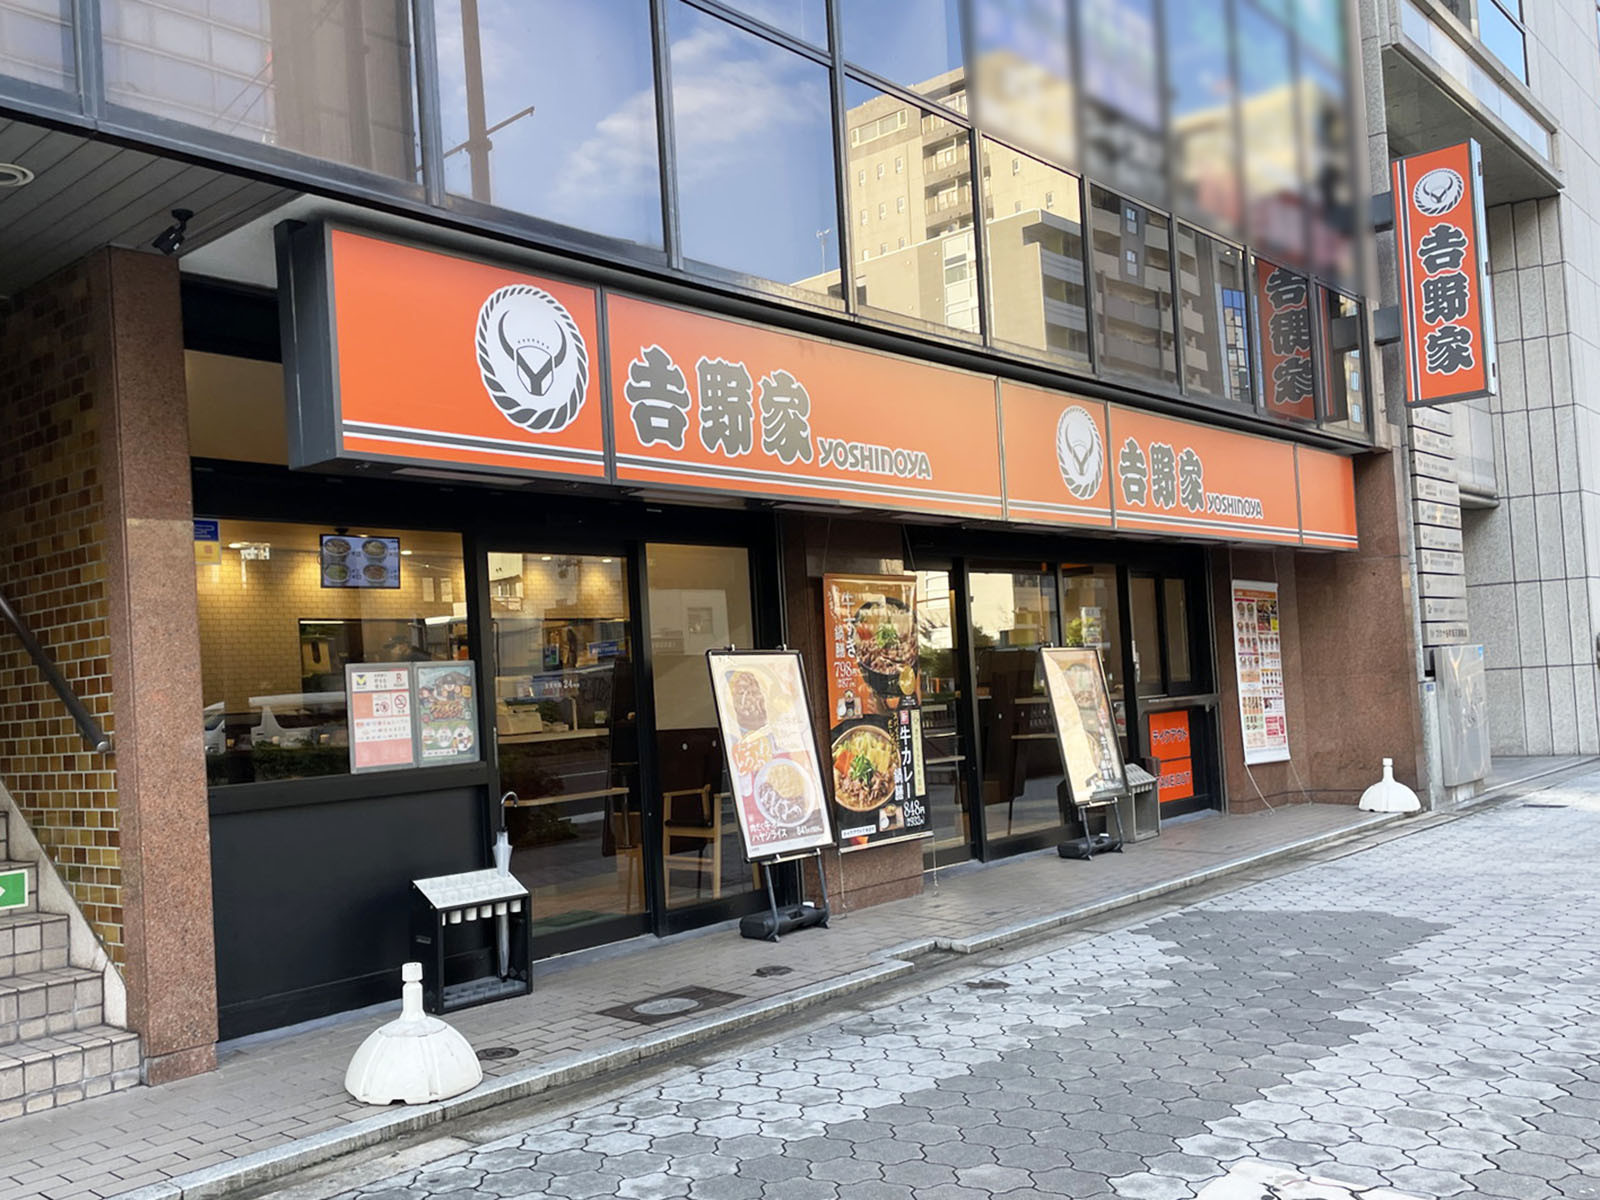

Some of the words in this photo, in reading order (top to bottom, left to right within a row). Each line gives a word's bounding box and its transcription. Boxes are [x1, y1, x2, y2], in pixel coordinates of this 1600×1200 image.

[1418, 222, 1474, 375] 吉野家
[624, 344, 814, 465] 吉野家
[817, 437, 932, 480] YOSHINOYA
[1119, 437, 1205, 512] 吉野家
[1206, 492, 1263, 519] YOSHINOYA
[899, 725, 913, 799] 牛カレー
